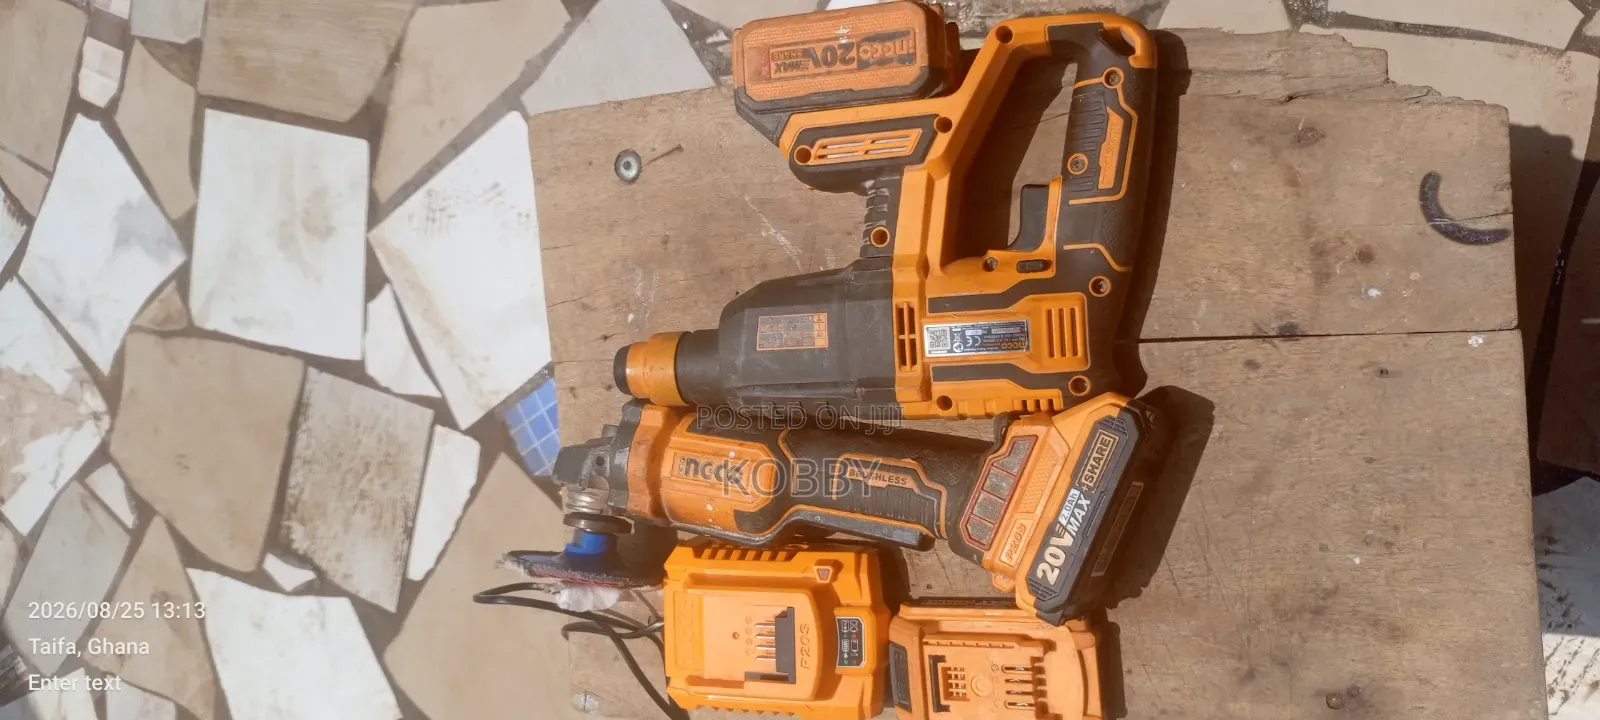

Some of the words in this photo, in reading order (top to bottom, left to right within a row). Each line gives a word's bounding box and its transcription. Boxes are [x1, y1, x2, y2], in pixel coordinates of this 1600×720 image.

[849, 468, 908, 486] BRUSHLESS
[1083, 436, 1111, 484] SHARE
[1059, 492, 1079, 524] 2.0Ah
[1036, 528, 1075, 585] 20V
[1065, 494, 1091, 535] MAX
[800, 623, 811, 670] P20S
